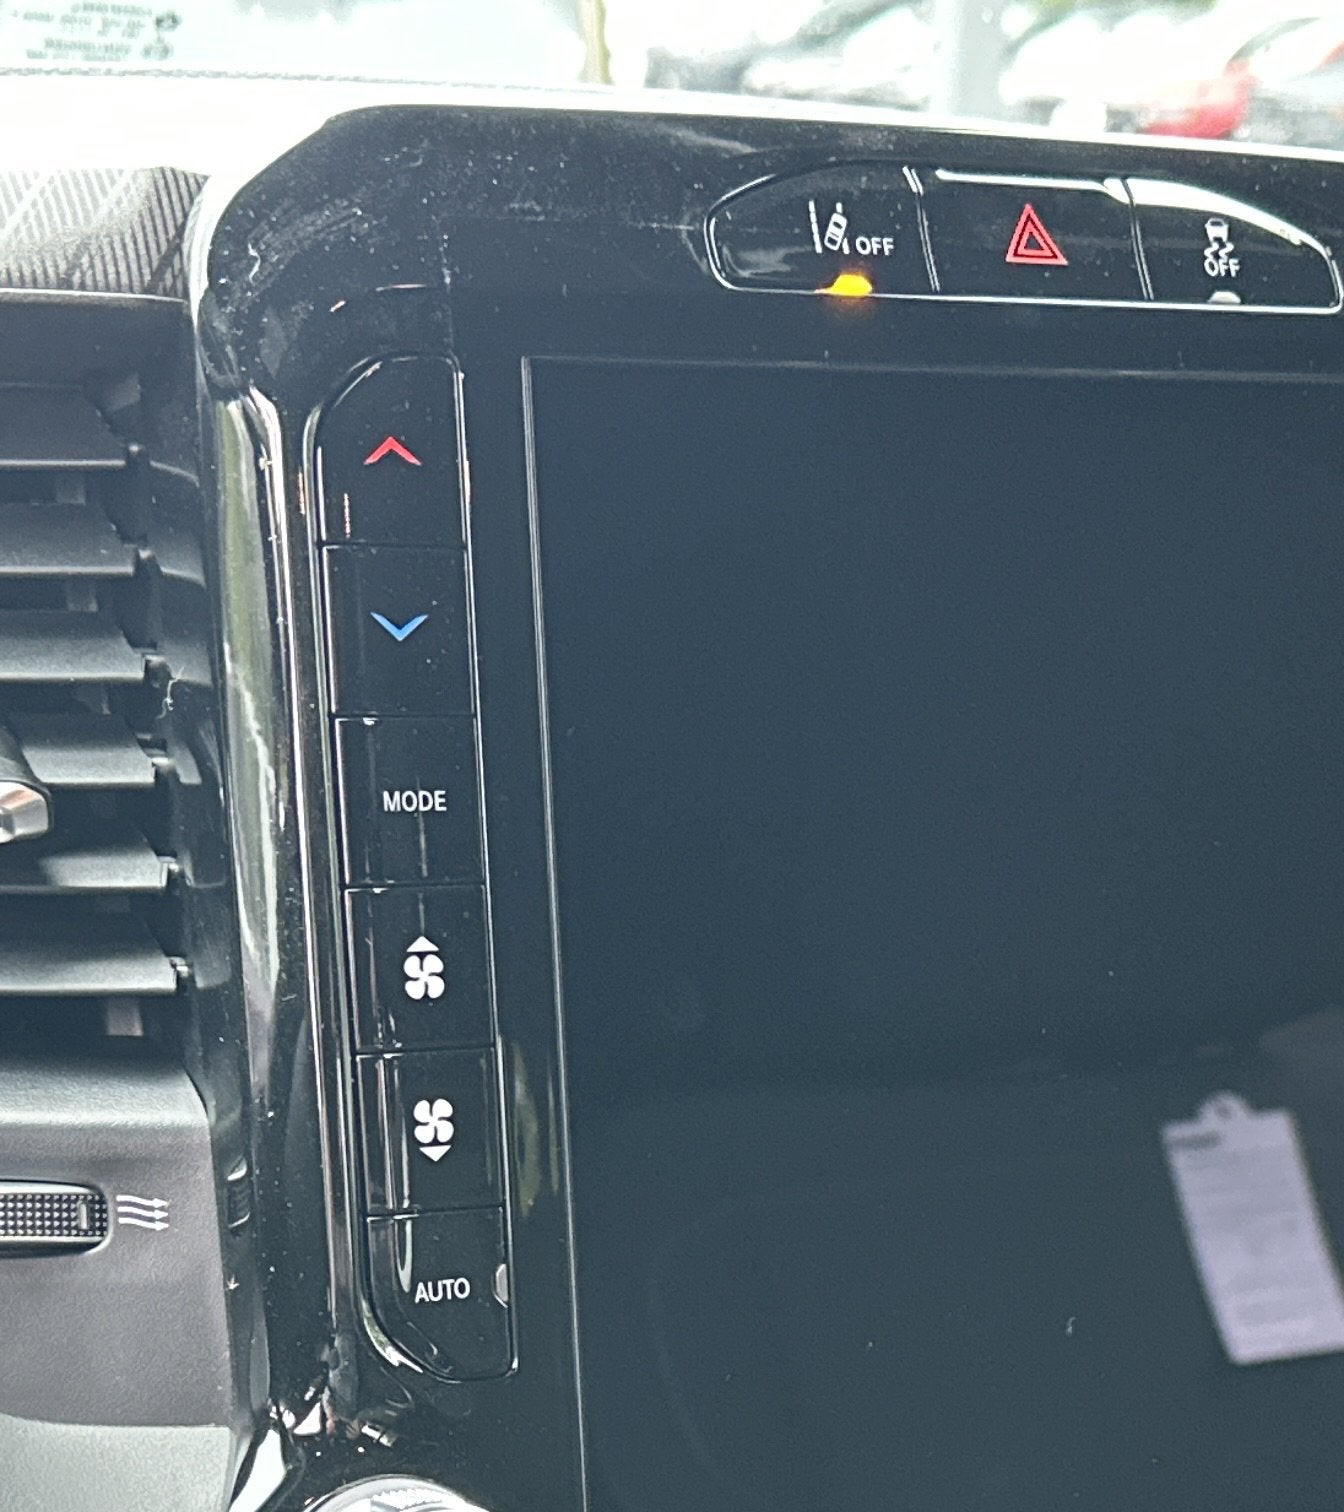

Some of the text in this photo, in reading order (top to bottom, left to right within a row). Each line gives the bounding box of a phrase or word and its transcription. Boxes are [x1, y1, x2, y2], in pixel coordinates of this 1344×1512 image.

[855, 236, 894, 256] OFF
[1204, 258, 1240, 279] OFF
[383, 791, 447, 812] MODE
[415, 1277, 470, 1303] AUTO
